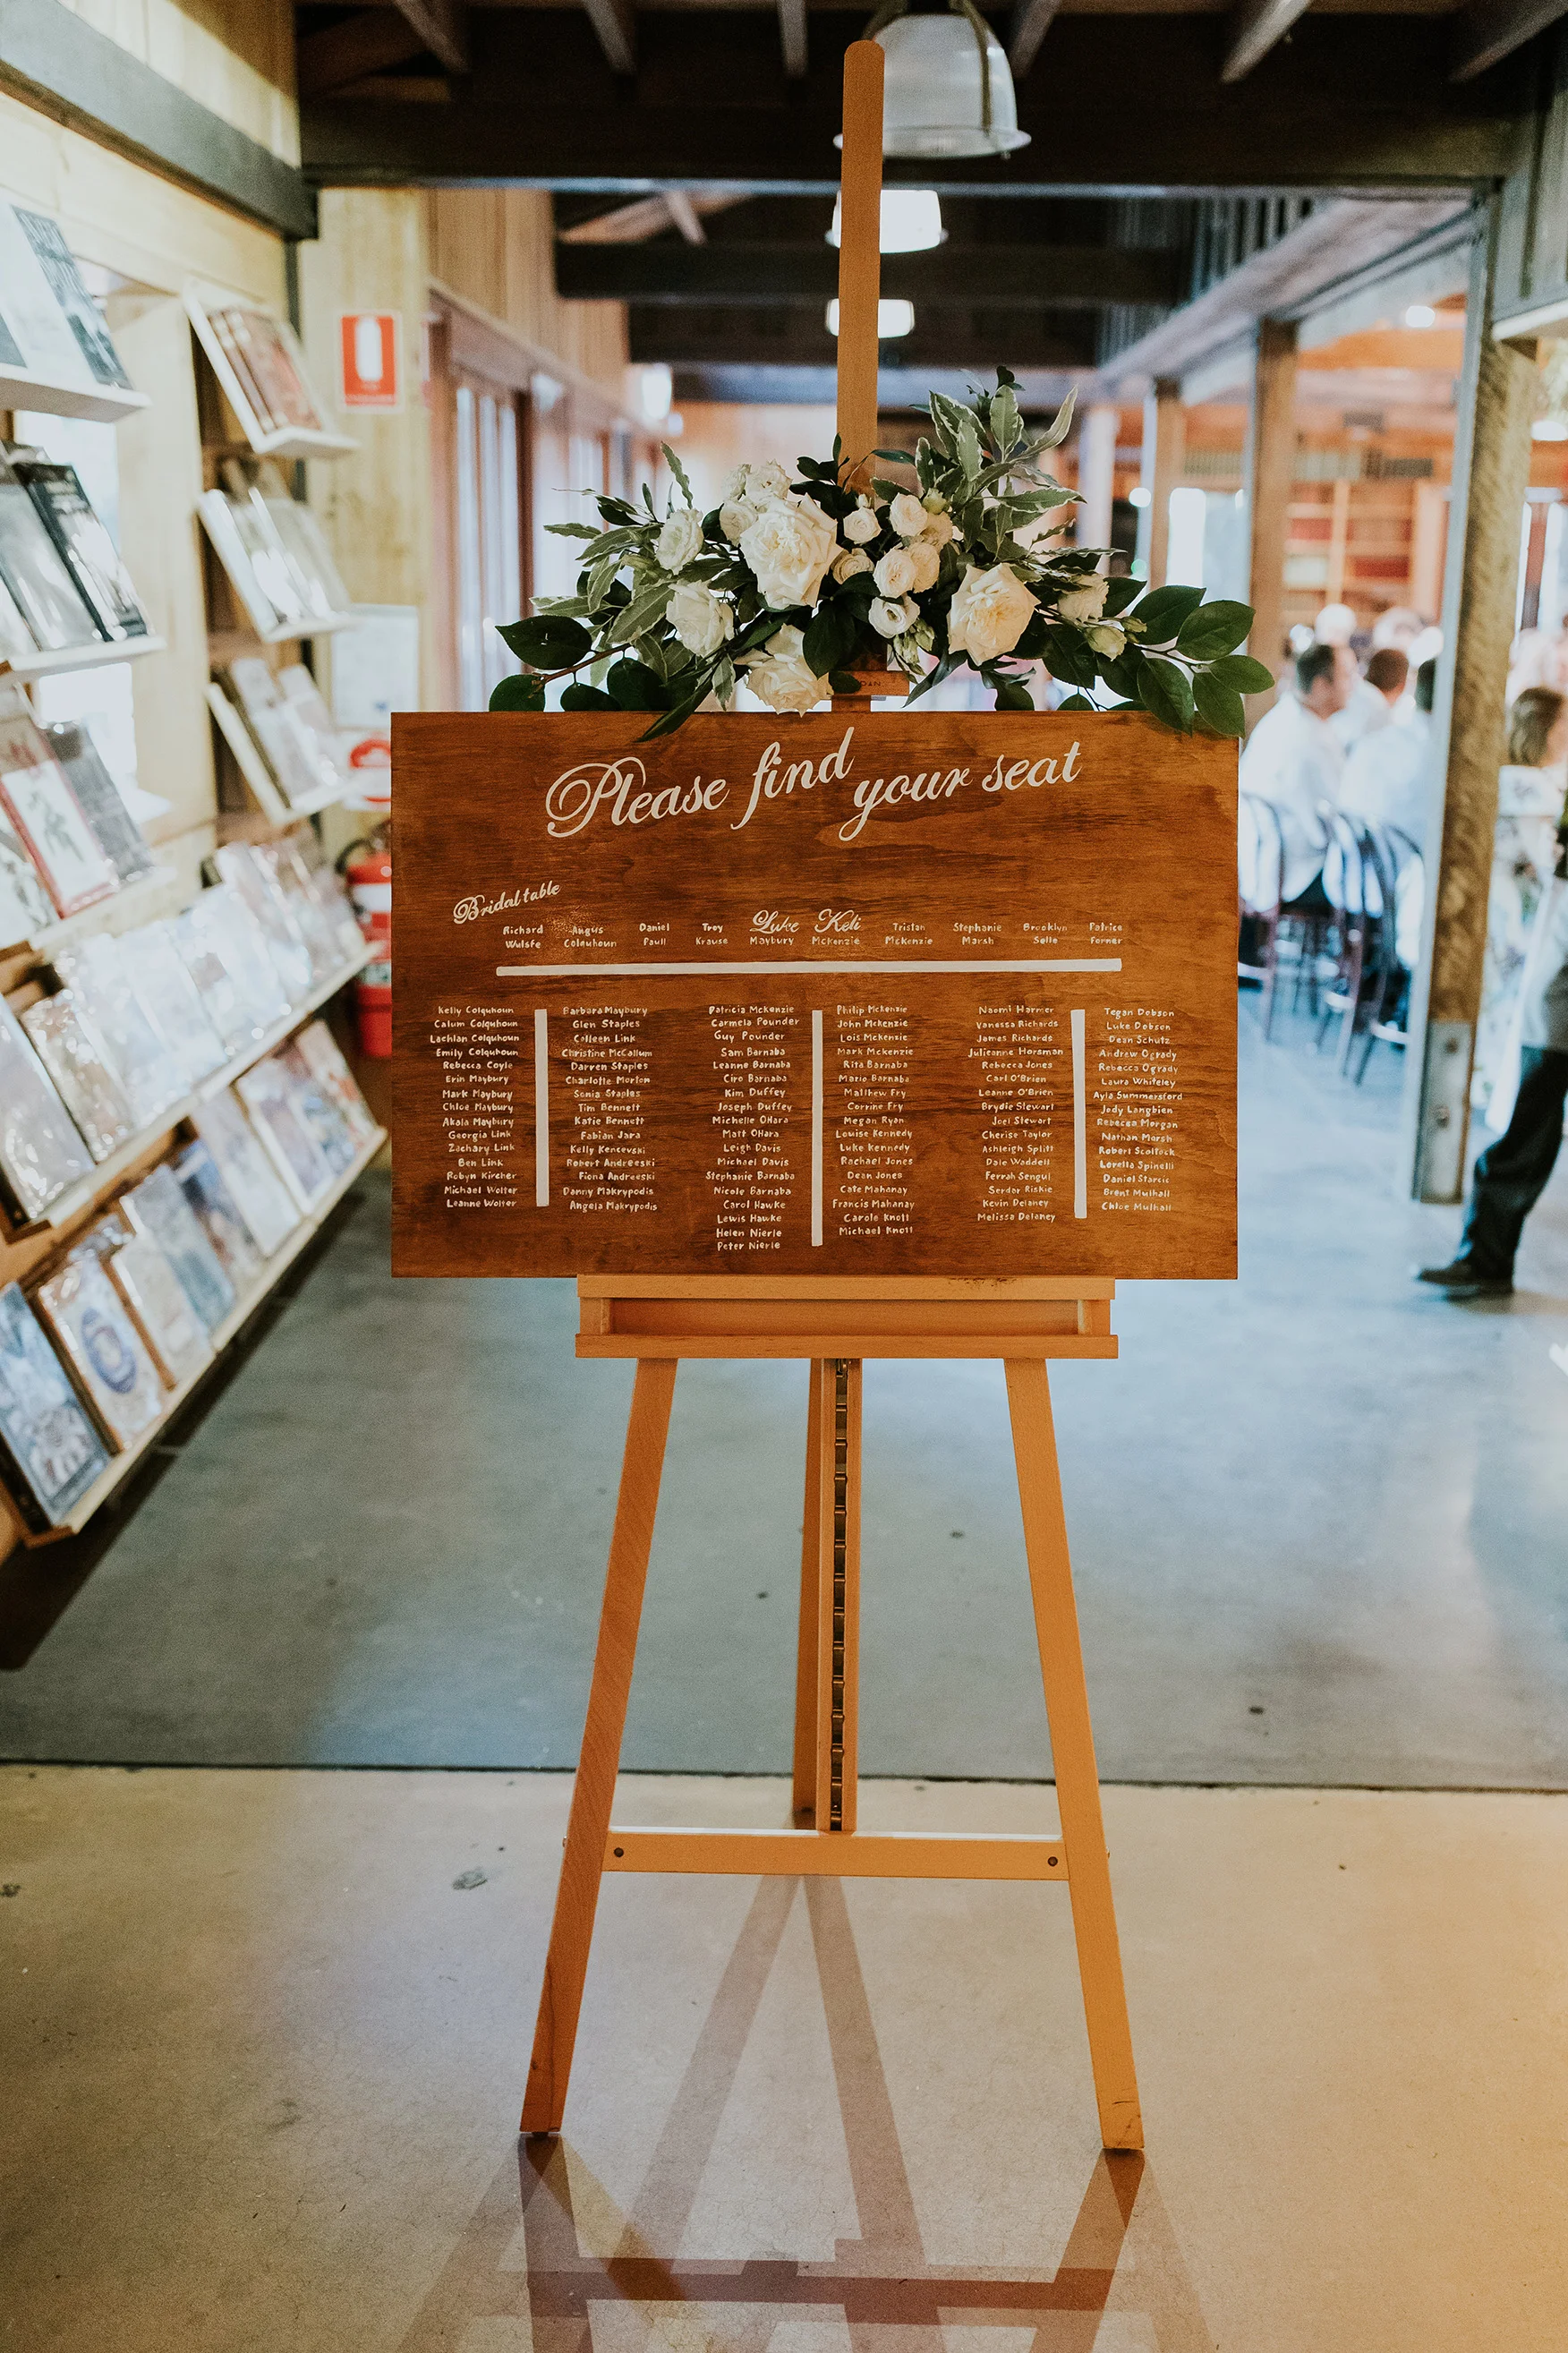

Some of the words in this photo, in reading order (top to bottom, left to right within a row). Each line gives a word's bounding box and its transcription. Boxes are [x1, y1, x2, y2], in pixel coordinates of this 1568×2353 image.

[545, 756, 729, 839] Please
[730, 726, 856, 831] find
[838, 766, 973, 841] your
[981, 741, 1083, 791] seat
[523, 880, 561, 902] table
[750, 909, 800, 934] Luke
[503, 925, 543, 935] Richard
[639, 923, 669, 933] Daniel
[703, 923, 723, 933] Troy
[893, 923, 925, 932] Tristan
[952, 922, 1002, 934] Stephanie
[1023, 923, 1068, 933] Brooklyn
[1089, 923, 1122, 932] Patrice
[564, 938, 617, 949] Colquhoun
[750, 936, 795, 947] Maybury
[1104, 1008, 1133, 1019] Tegan
[1138, 1008, 1174, 1017] Dobson
[434, 1019, 464, 1028] Calum
[471, 1019, 518, 1029] Colquhoun
[573, 1019, 596, 1028] Glen
[601, 1019, 640, 1029] Staples
[712, 1019, 752, 1027] Carmela
[757, 1018, 799, 1026] Pounder
[837, 1019, 861, 1027] John
[976, 1021, 1016, 1029] Vanessa
[1106, 1022, 1130, 1030] Luke
[1135, 1022, 1171, 1030] Dobson
[430, 1035, 467, 1043] Lachlan
[472, 1034, 519, 1044] Colquhoun
[574, 1035, 610, 1043] Colleen
[615, 1034, 635, 1043] Link
[714, 1030, 734, 1043] Guy
[742, 1031, 785, 1041] Pounder
[977, 1035, 1007, 1043] James
[1011, 1034, 1053, 1042] Richards
[1109, 1036, 1133, 1044] Dean
[436, 1048, 463, 1058] Emily
[469, 1048, 518, 1057] Colquhoun
[562, 1049, 605, 1057] Christine
[720, 1048, 743, 1056] Sam
[747, 1047, 786, 1056] Barnaba
[443, 1061, 481, 1070] Rebecca
[487, 1061, 513, 1071] Coyle
[571, 1062, 607, 1070] Darren
[611, 1062, 648, 1072] Staples
[713, 1061, 748, 1070] Leanne
[753, 1061, 790, 1069] Barnaba
[844, 1061, 864, 1069] Rita
[867, 1061, 908, 1069] Barnaba
[446, 1075, 464, 1083] Erin
[470, 1075, 508, 1085] Maybury
[723, 1075, 743, 1083] Ciro
[748, 1074, 787, 1082] Barnaba
[1010, 1075, 1046, 1083] O'Brien
[442, 1089, 468, 1097] Mark
[473, 1089, 513, 1102] Maybury
[574, 1090, 601, 1098] Sonia
[606, 1089, 641, 1100] Staples
[725, 1089, 744, 1097] Kim
[749, 1087, 786, 1098] Duffey
[1018, 1088, 1053, 1096] O'Brien
[442, 1103, 470, 1111] Chloe
[474, 1103, 514, 1113] Maybury
[578, 1104, 595, 1112] Tim
[601, 1103, 640, 1111] Bennett
[718, 1103, 752, 1113] Joseph
[757, 1103, 792, 1113] Duffey
[887, 1102, 904, 1113] Fry
[1016, 1103, 1054, 1111] Stewart
[575, 1117, 601, 1125] Katie
[606, 1117, 644, 1125] Bennett
[844, 1117, 877, 1126] Megan
[882, 1115, 904, 1127] Ryan
[992, 1117, 1010, 1125] Joel
[1014, 1117, 1051, 1125] Stewart
[448, 1130, 487, 1142] Georgia
[491, 1130, 511, 1138] Link
[581, 1131, 613, 1139] Fabian
[618, 1131, 641, 1139] Jara
[722, 1130, 746, 1138] Matt
[836, 1130, 869, 1138] Louise
[982, 1130, 1018, 1138] Cherise
[1023, 1130, 1052, 1140] Taylor
[1102, 1132, 1138, 1141] Nathan
[494, 1143, 516, 1152] Link
[723, 1144, 751, 1155] Leigh
[755, 1144, 781, 1153] Davis
[458, 1158, 477, 1166] Ben
[481, 1158, 503, 1166] Link
[717, 1157, 757, 1166] Michael
[762, 1157, 788, 1166] Davis
[841, 1156, 881, 1165] Rachael
[885, 1157, 913, 1165] Jones
[986, 1158, 1008, 1166] Dale
[705, 1172, 753, 1181] Stephanie
[757, 1172, 795, 1180] Barnaba
[848, 1172, 873, 1180] Dean
[875, 1172, 903, 1180] Jones
[714, 1187, 745, 1196] Nicole
[750, 1187, 791, 1196] Barnaba
[840, 1186, 862, 1194] Cate
[1104, 1189, 1129, 1197] Brent
[447, 1199, 481, 1207] Leanne
[723, 1200, 750, 1209] Carol
[754, 1200, 786, 1209] Hawke
[833, 1199, 868, 1208] Francis
[1012, 1199, 1049, 1208] Delaney
[717, 1215, 746, 1223] Lewis
[750, 1215, 782, 1223] Hawke
[844, 1214, 879, 1222] Carole
[977, 1213, 1015, 1222] Melissa
[1018, 1213, 1055, 1223] Delaney
[716, 1229, 745, 1238] Helen
[717, 1242, 744, 1251] Peter
